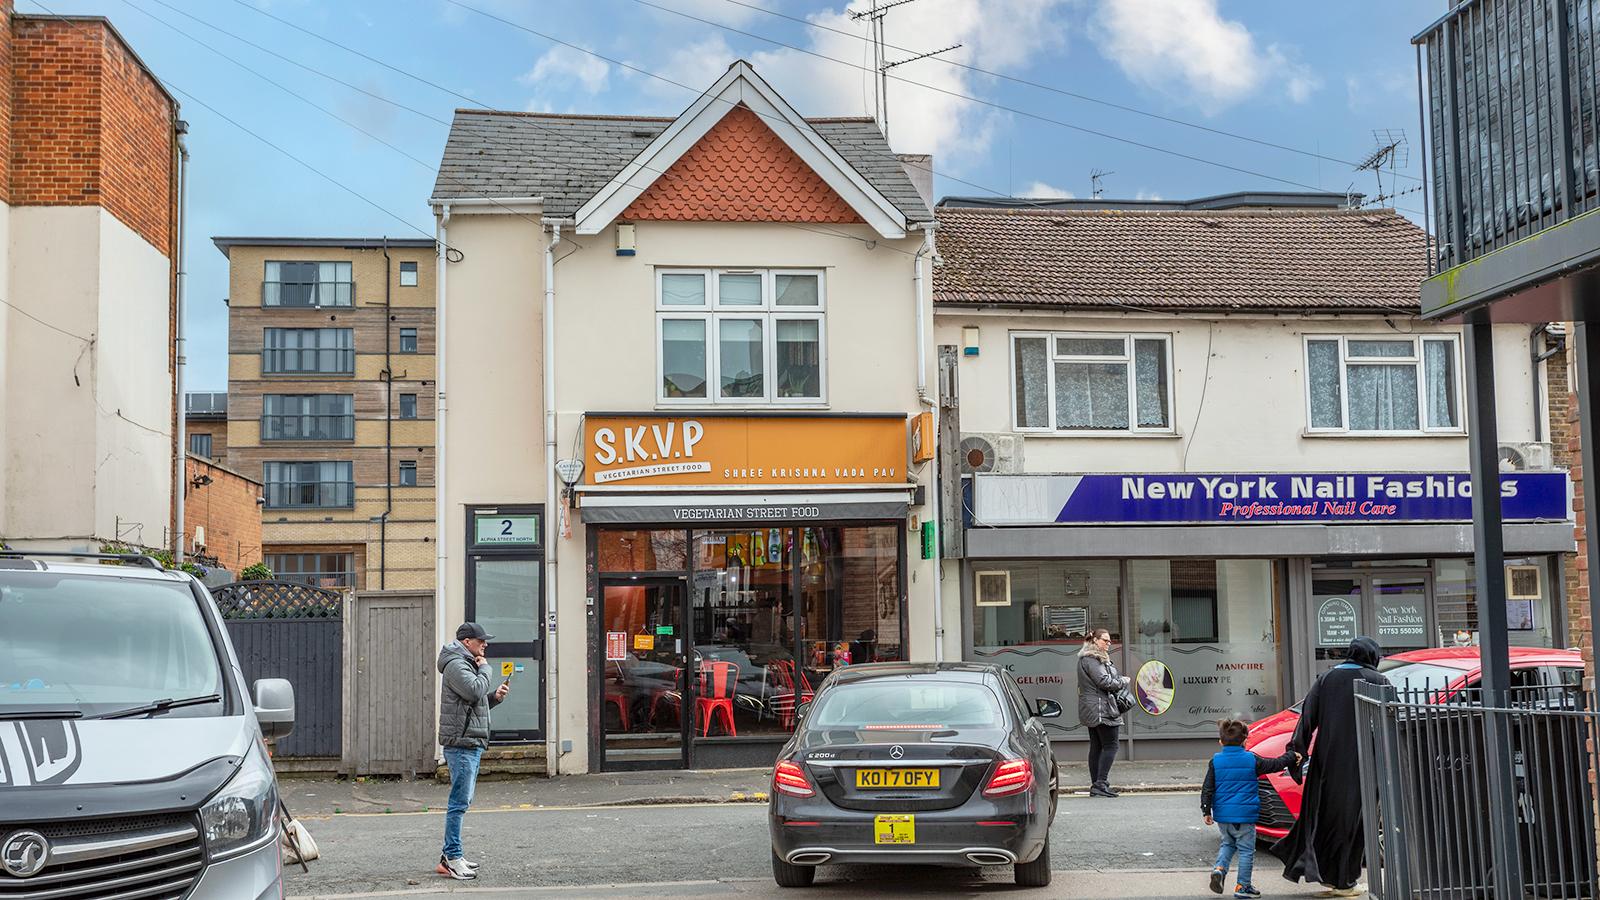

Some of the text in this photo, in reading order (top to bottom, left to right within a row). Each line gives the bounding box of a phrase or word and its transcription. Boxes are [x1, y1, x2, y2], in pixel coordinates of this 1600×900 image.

[594, 420, 704, 465] S.K.V.P
[602, 468, 650, 480] VEGETARIAN
[724, 468, 896, 478] SHREE KRISHNA VADA PAV
[1121, 475, 1518, 500] New York Nail Fashios
[673, 506, 820, 519] VEGETARIAN STREET FOOD
[1218, 501, 1397, 518] Professional Nail Care
[501, 520, 512, 535] 2
[1382, 605, 1417, 614] New York
[1378, 615, 1423, 623] Nail Fashion
[1017, 676, 1034, 684] GEL
[1183, 676, 1219, 684] LUXURY
[1188, 704, 1202, 716] Gift
[861, 772, 900, 785] KO17
[889, 823, 894, 833] 1
